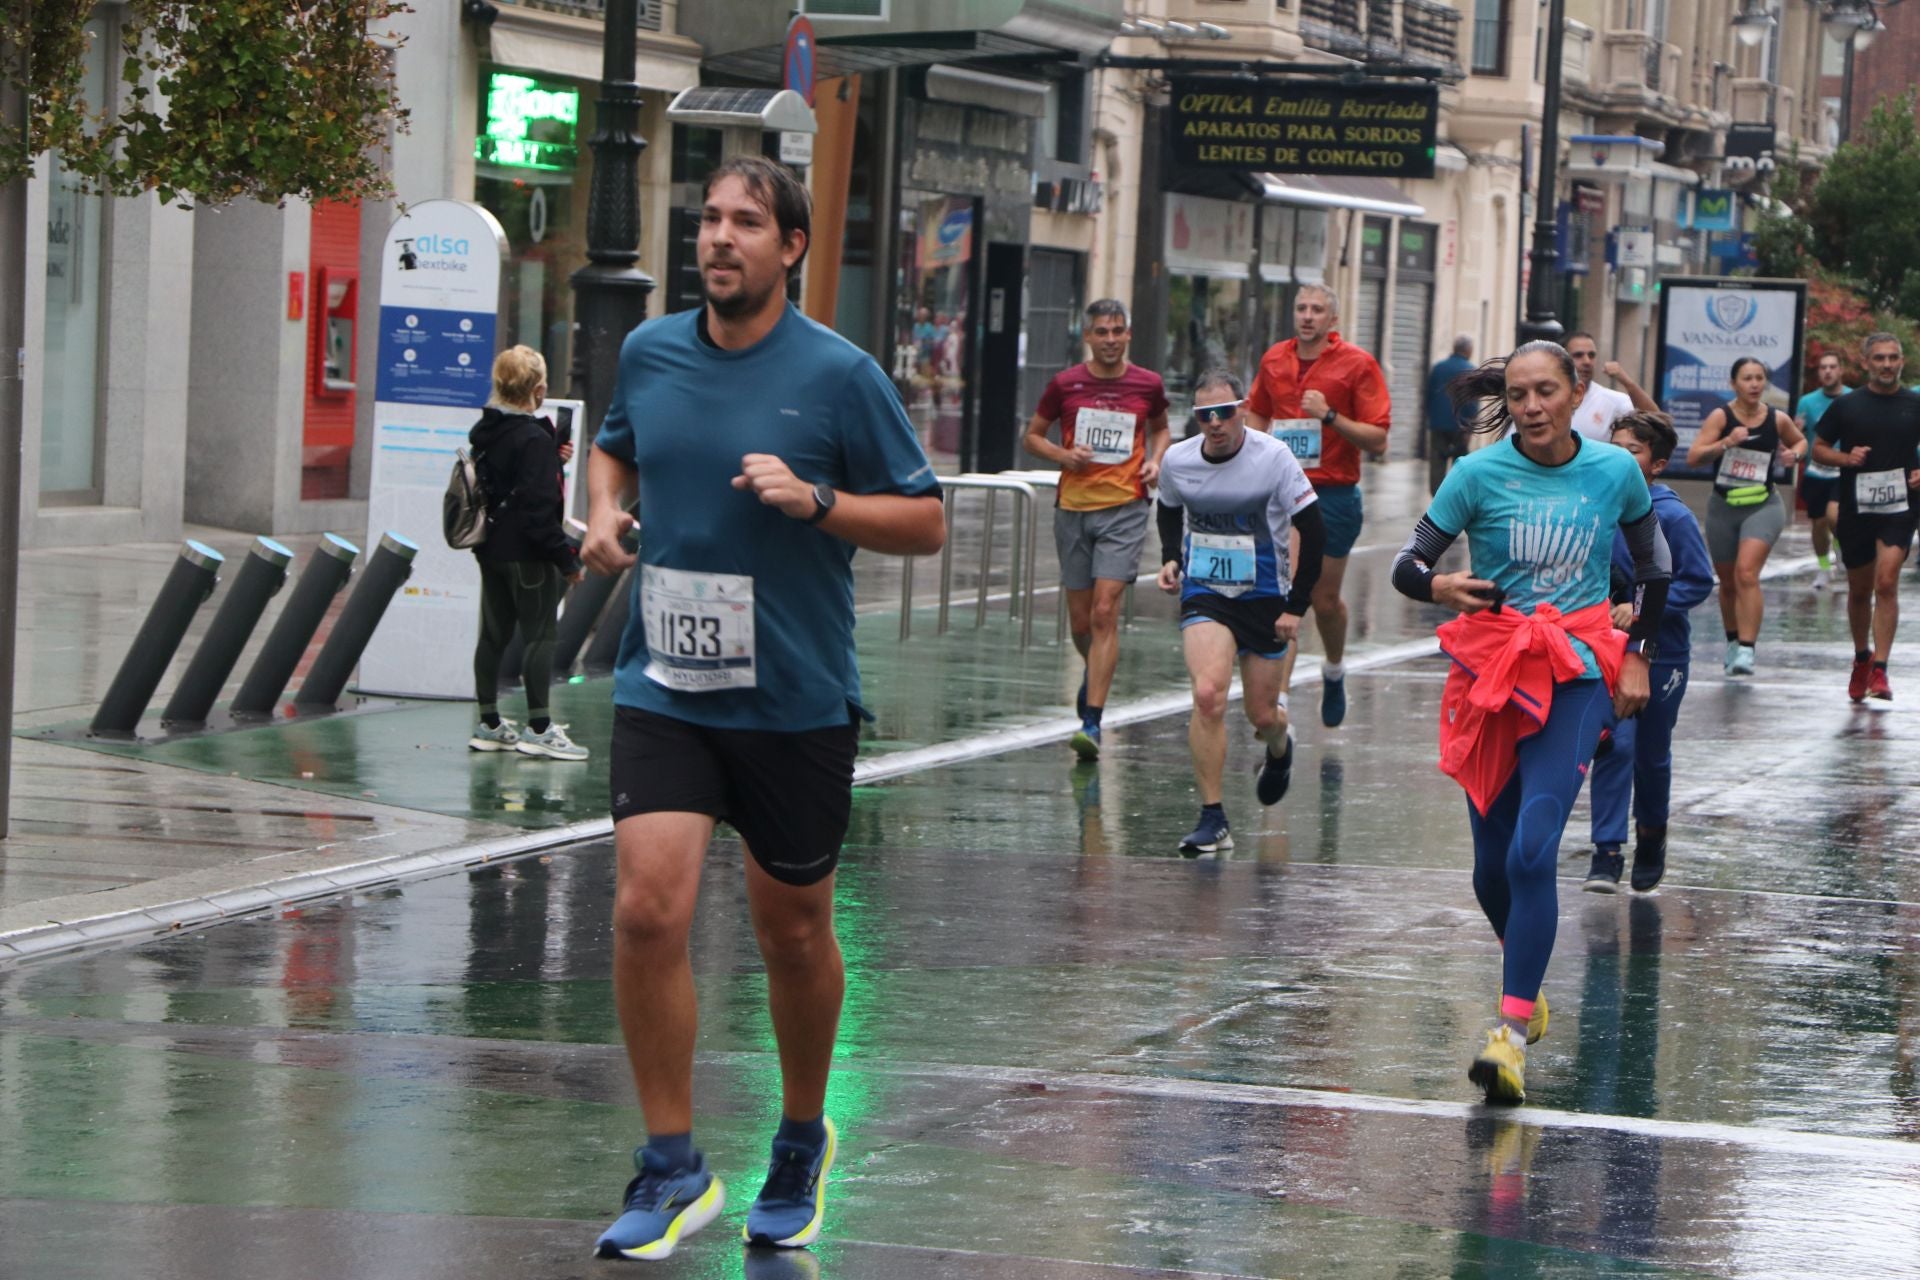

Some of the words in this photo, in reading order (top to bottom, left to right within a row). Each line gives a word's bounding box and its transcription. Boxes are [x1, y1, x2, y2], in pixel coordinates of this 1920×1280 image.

[1179, 94, 1253, 115] OPTICA
[1264, 96, 1331, 117] Emilia
[1339, 98, 1428, 119] Barriada
[1183, 121, 1281, 137] APARATOS
[1286, 124, 1337, 140] PARA
[1344, 126, 1421, 144] SORDOS
[1198, 144, 1267, 162] LENTES
[1274, 147, 1300, 163] DE
[1306, 148, 1404, 167] CONTACTO
[416, 233, 469, 255] alsa
[1086, 427, 1122, 449] 1067
[1869, 485, 1896, 503] 750
[1209, 556, 1232, 579] 211
[661, 610, 722, 657] 1133
